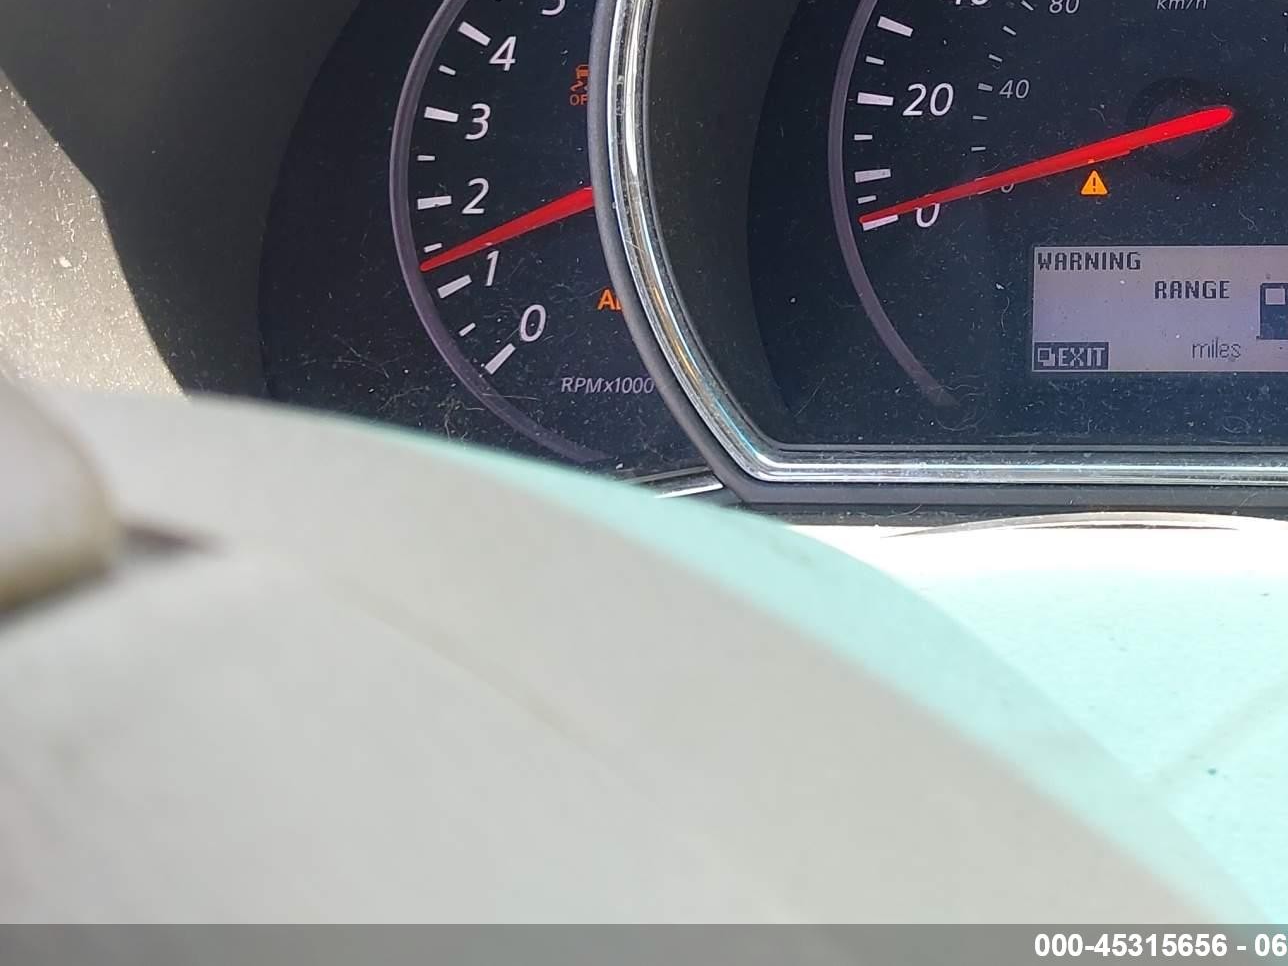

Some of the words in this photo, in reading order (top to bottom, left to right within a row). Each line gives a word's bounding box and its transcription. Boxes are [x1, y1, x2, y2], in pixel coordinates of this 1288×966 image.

[489, 37, 516, 71] 4
[903, 83, 953, 115] 20
[1000, 80, 1029, 98] 40
[466, 104, 490, 139] 3
[463, 178, 488, 213] 2
[486, 251, 498, 286] 1
[1038, 252, 1140, 270] WARNING
[1155, 281, 1229, 299] RANGE
[520, 305, 545, 341] 0
[1059, 348, 1105, 366] EXIT
[1193, 338, 1240, 358] miles
[561, 377, 655, 394] RPMx1000
